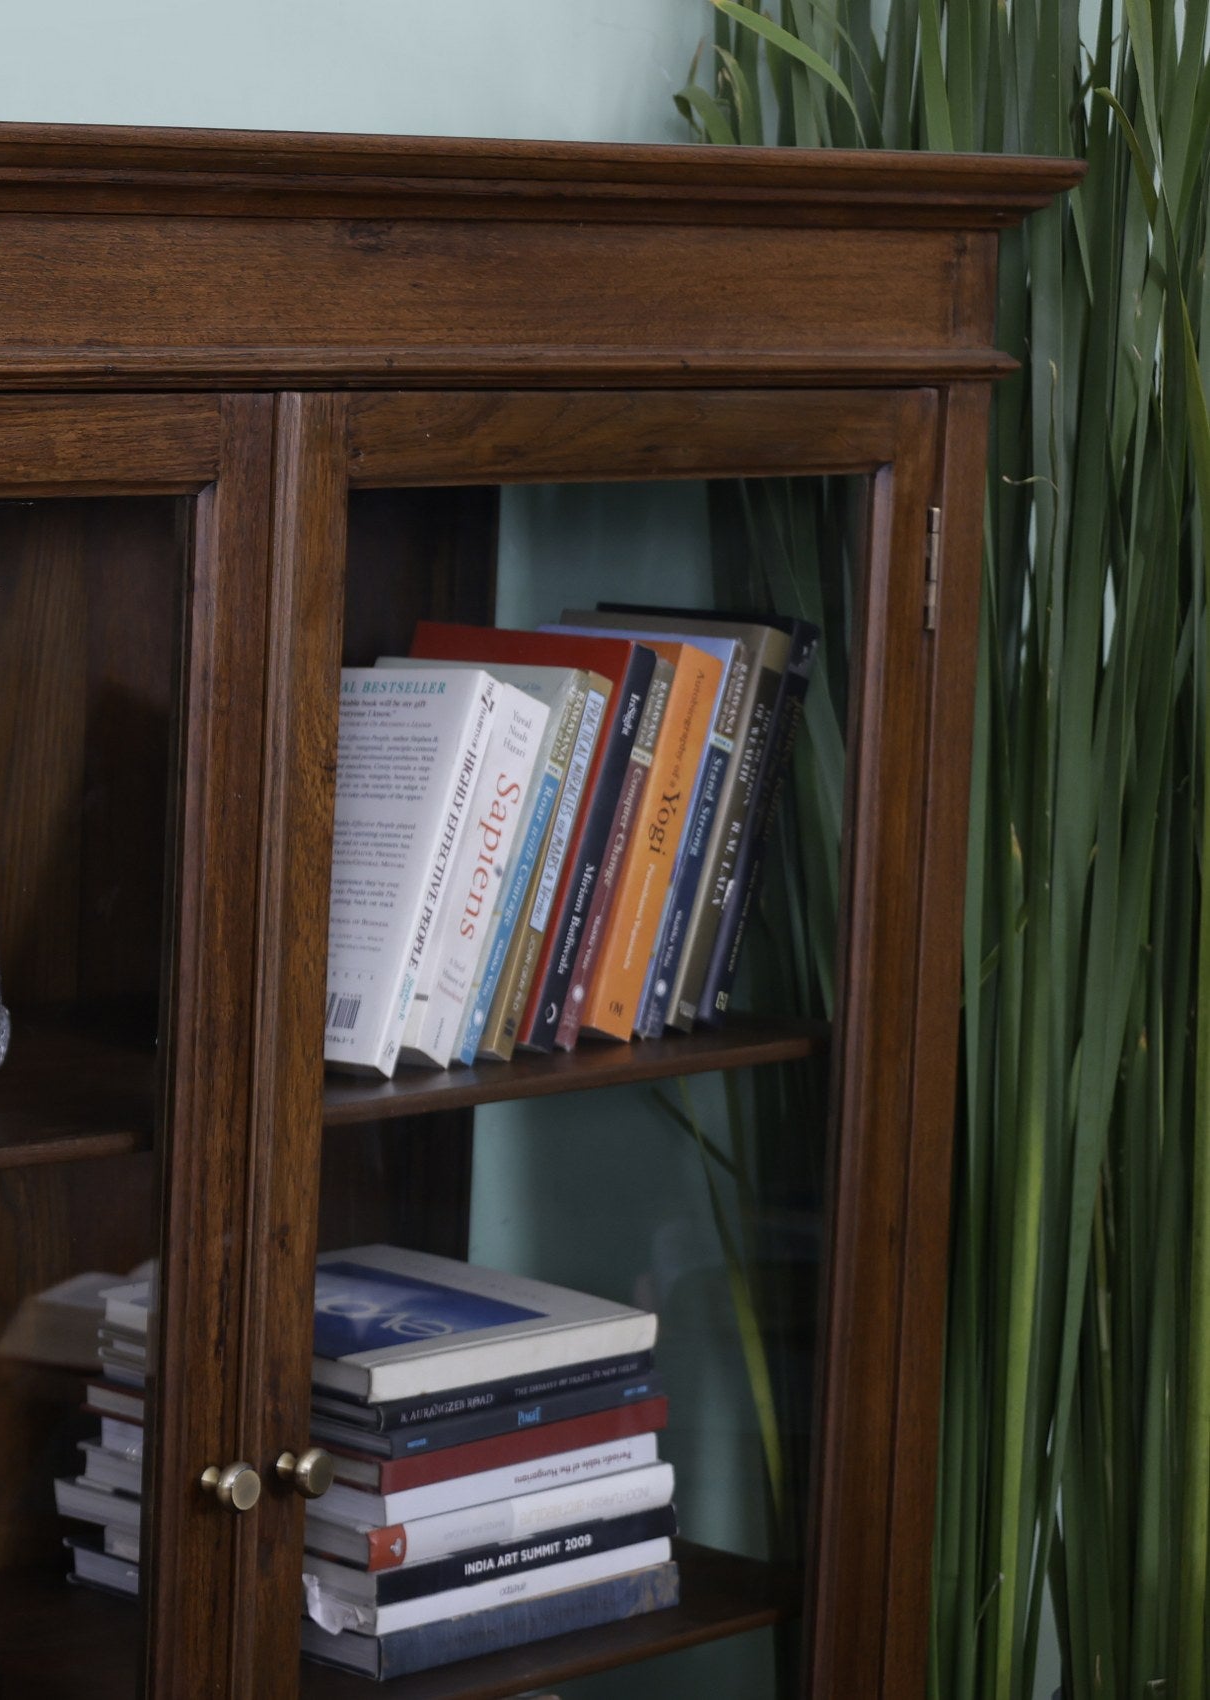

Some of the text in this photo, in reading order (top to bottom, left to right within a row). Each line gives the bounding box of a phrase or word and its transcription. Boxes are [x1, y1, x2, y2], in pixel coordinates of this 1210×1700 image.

[362, 681, 446, 694] BESTSELLER
[481, 694, 495, 713] 7
[509, 724, 528, 743] Noah
[513, 710, 533, 730] Yuval
[557, 690, 585, 761] RAMAYANA
[575, 699, 601, 759] PRACTICAL
[621, 693, 640, 736] InSight
[645, 681, 667, 747] RAMAYANA
[676, 669, 705, 763] Autobiography
[503, 737, 526, 759] Harari
[452, 749, 477, 813] HIGHLY
[559, 763, 583, 818] MIRACLES
[673, 766, 681, 779] of
[536, 786, 554, 822] Roar
[648, 791, 681, 856] Yogi
[690, 756, 724, 858] Stand Strong
[525, 826, 539, 862] with
[604, 767, 642, 888] Conquer Change
[427, 812, 459, 905] EFFECTIVE
[460, 772, 520, 940] Sapiens
[547, 834, 565, 870] MARS
[504, 864, 528, 927] Courage
[574, 862, 596, 912] Miriam
[408, 906, 433, 971] PEOPLE
[410, 1393, 494, 1421] AURANGZEB ROAD
[514, 1387, 528, 1397] THE
[514, 1451, 632, 1484] Periodic table of the Hungarians
[464, 1533, 593, 1576] INDIA ART SUMMIT 2009
